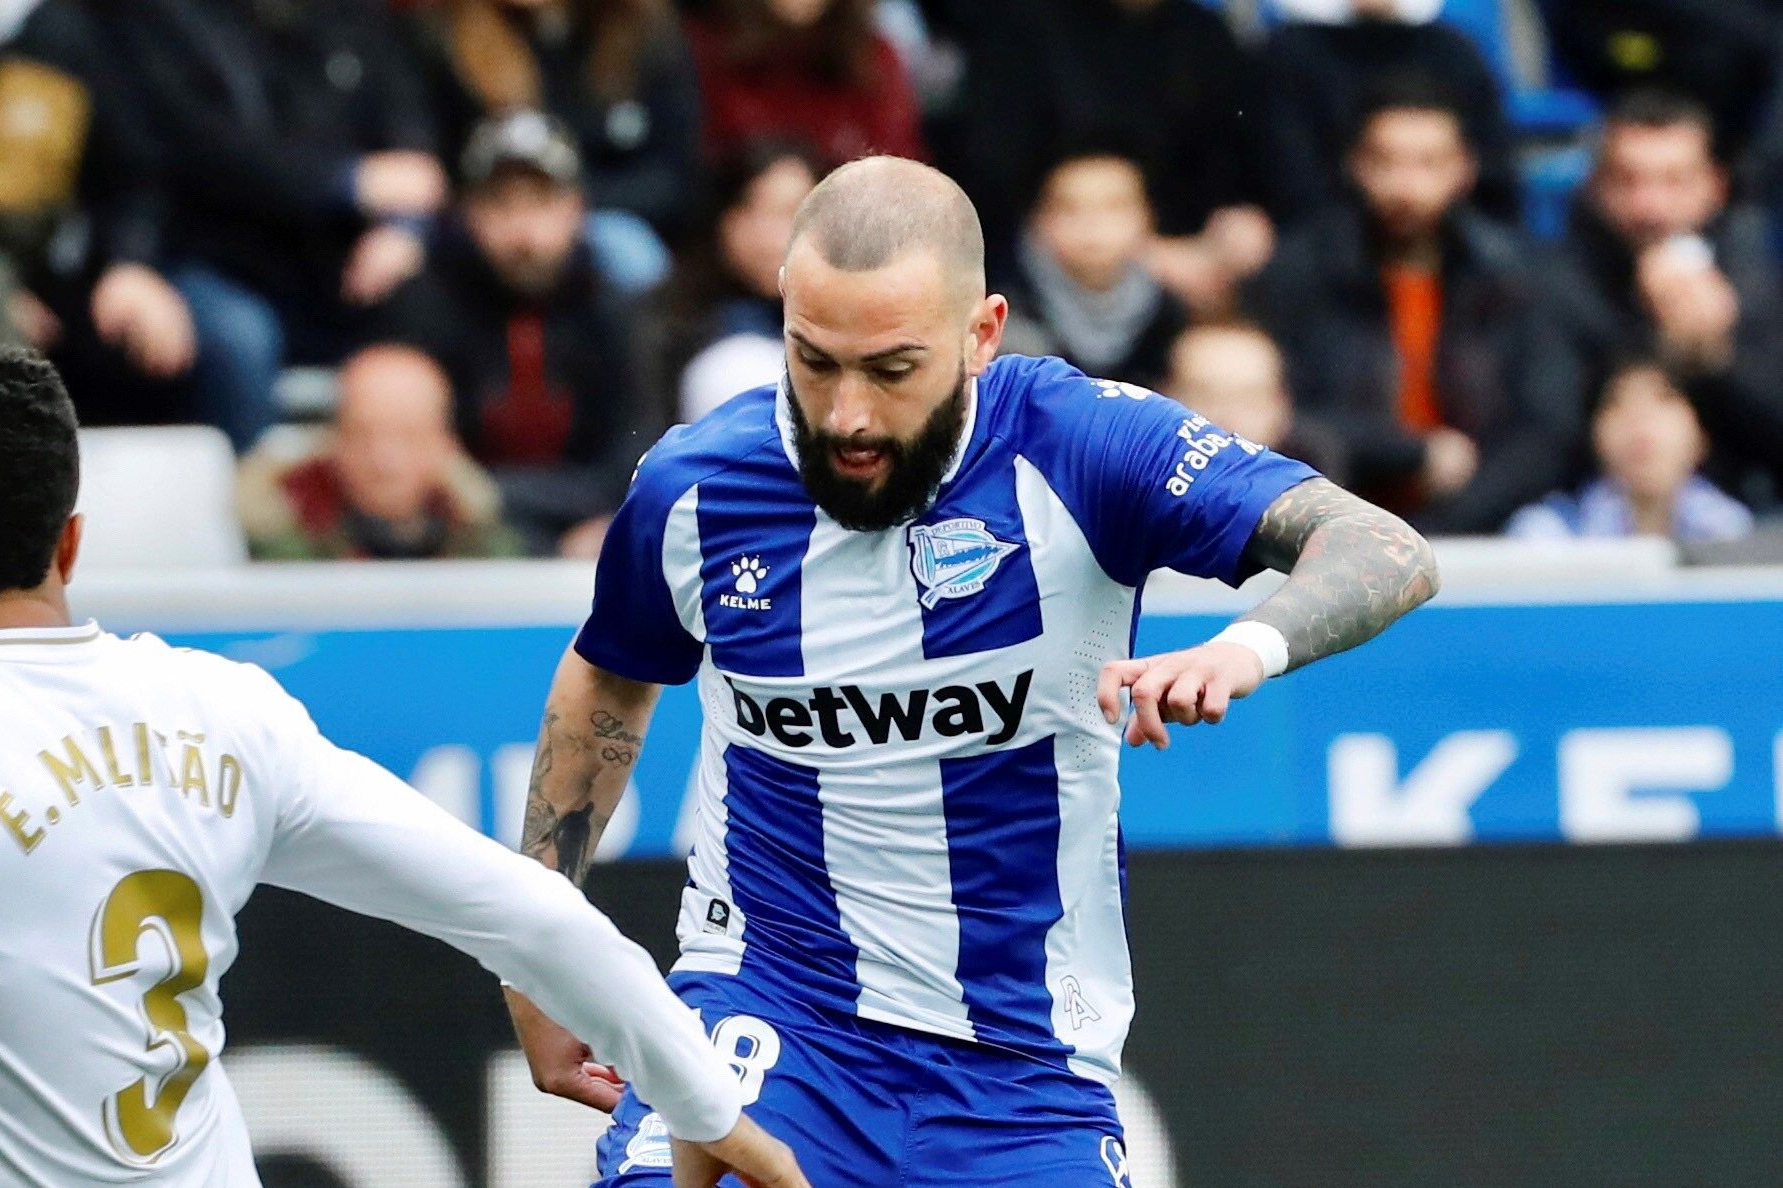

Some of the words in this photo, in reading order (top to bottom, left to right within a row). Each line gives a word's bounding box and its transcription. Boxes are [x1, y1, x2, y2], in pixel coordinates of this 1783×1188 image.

[719, 594, 772, 611] KELME
[723, 668, 1035, 749] betway
[87, 867, 210, 1169] 3
[693, 1007, 781, 1107] 8
